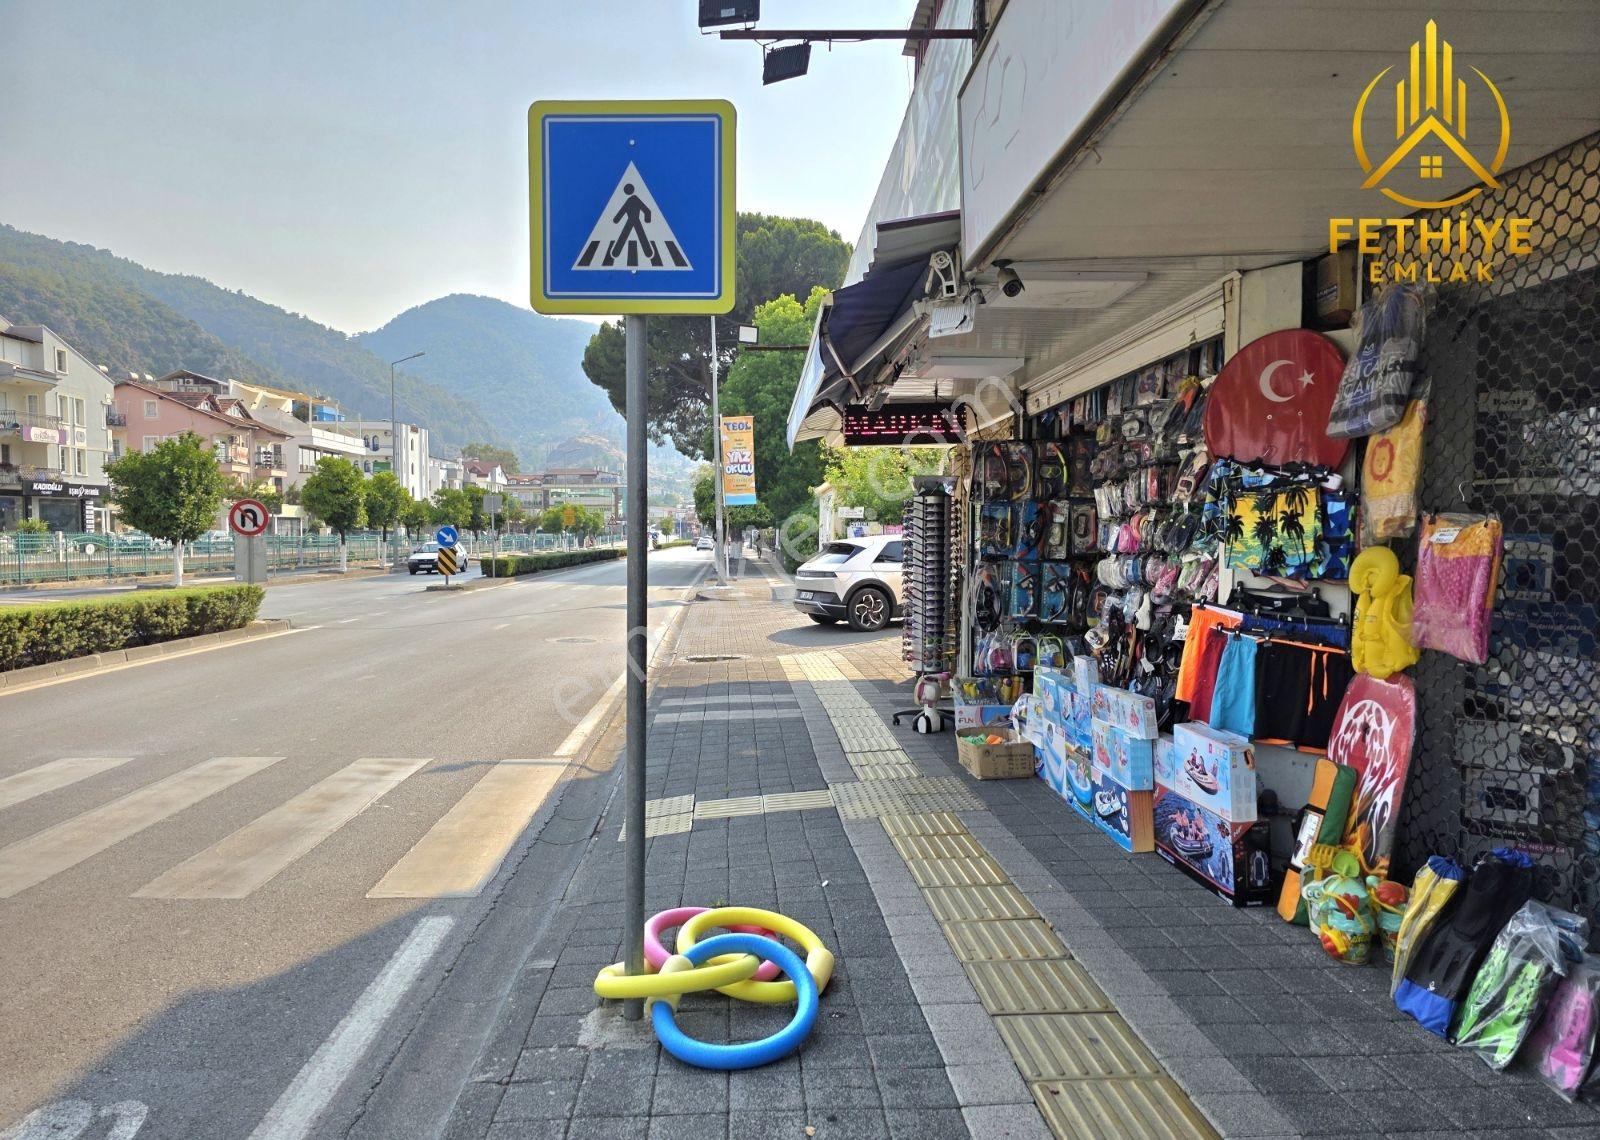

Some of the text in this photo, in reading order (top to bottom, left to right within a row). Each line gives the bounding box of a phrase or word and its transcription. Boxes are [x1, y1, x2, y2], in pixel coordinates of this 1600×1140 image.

[723, 422, 752, 431] TEOL
[726, 450, 752, 464] YAZ
[725, 463, 754, 475] OKULU
